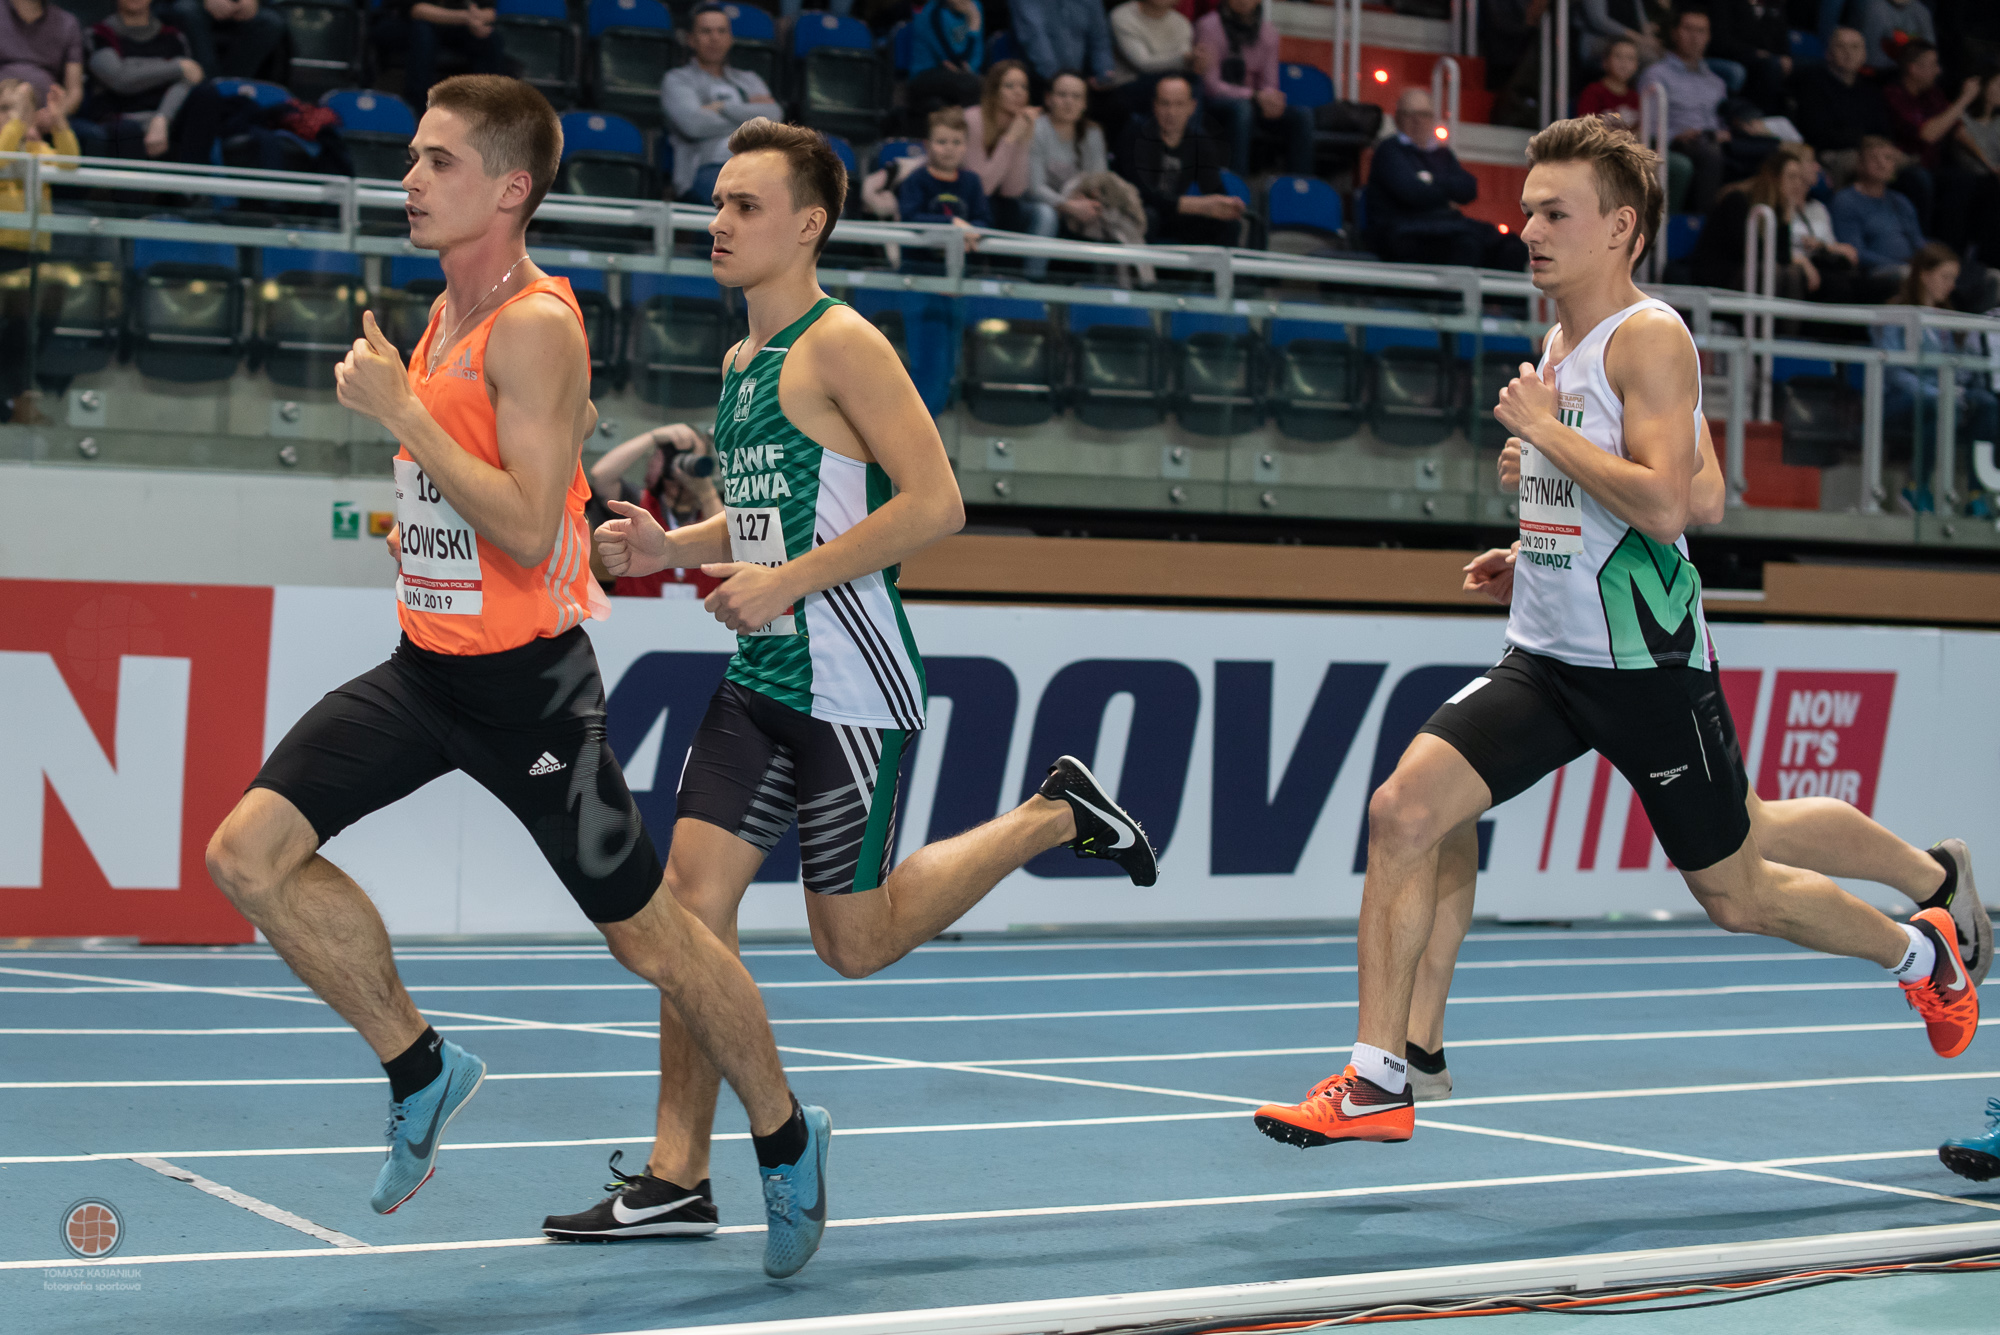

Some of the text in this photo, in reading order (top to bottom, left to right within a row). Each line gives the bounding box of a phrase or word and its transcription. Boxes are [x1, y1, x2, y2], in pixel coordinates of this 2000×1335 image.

[732, 444, 784, 474] AWF
[1520, 475, 1575, 508] USTYNIAK
[398, 521, 473, 560] ŁOWSKI
[736, 513, 770, 541] 127
[1533, 535, 1557, 550] 2019
[424, 593, 453, 609] 2019
[1787, 689, 1862, 728] NOW
[1780, 729, 1839, 767] IT'S
[1649, 764, 1688, 778] BROOKS
[1777, 768, 1862, 806] YOUR
[1893, 952, 1917, 975] PUMA
[1383, 1056, 1405, 1074] PUMA
